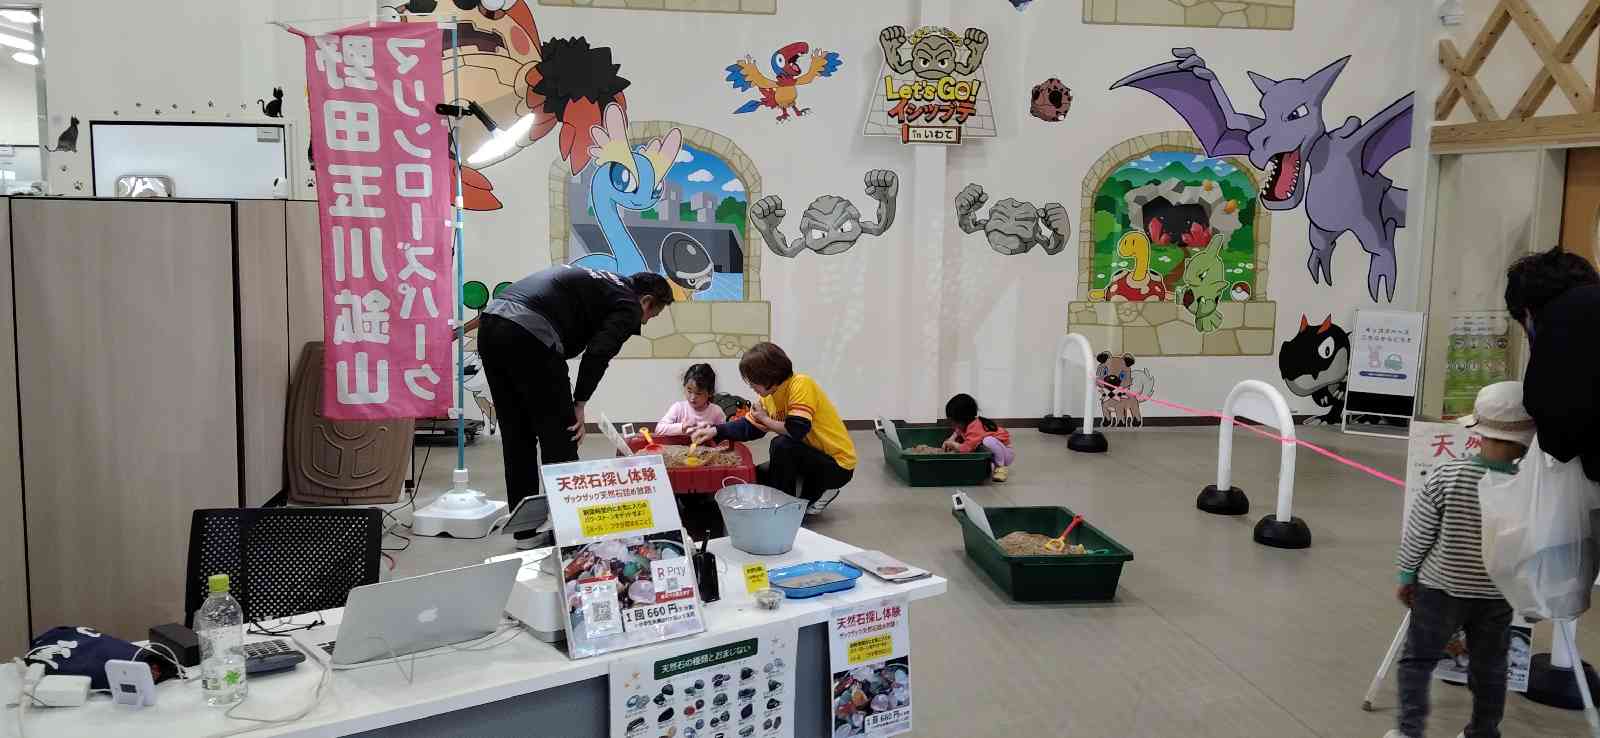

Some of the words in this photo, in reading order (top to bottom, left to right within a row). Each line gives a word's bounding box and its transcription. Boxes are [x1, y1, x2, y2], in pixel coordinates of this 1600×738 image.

[884, 75, 937, 102] Let's
[937, 75, 981, 104] GO!
[887, 97, 977, 124] イシツブテ
[924, 130, 953, 140] いわて
[556, 467, 657, 492] 天然石探し体験
[836, 607, 902, 630] 天然石探し体験
